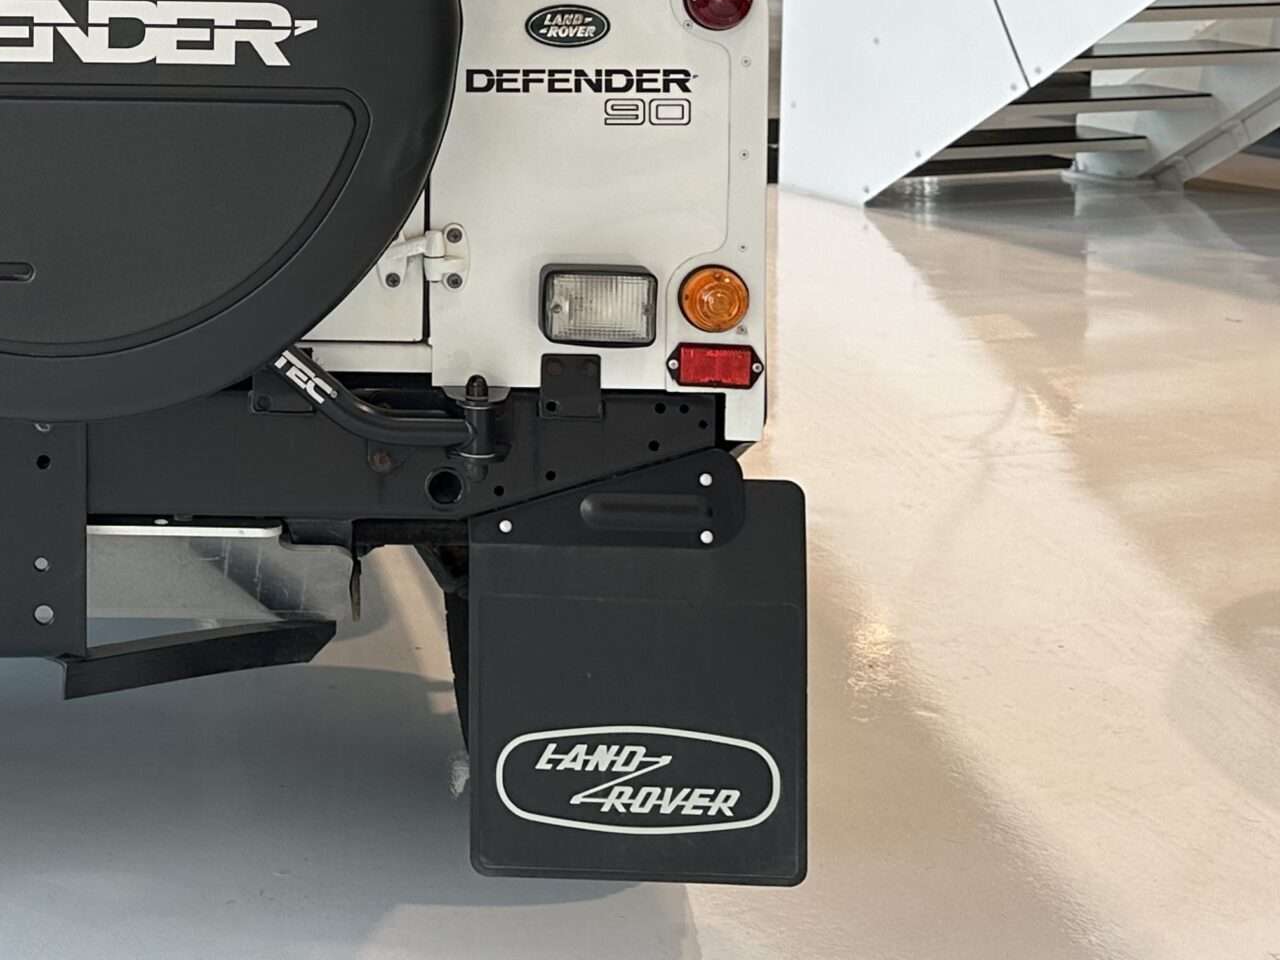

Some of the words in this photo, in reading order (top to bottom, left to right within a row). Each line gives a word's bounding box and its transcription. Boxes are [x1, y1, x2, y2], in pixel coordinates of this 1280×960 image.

[544, 13, 587, 26] LAND
[545, 25, 597, 38] ROVER
[465, 68, 698, 93] DEFENDER
[604, 97, 692, 126] 90
[534, 742, 647, 773] LAND
[599, 785, 742, 817] ROVER
